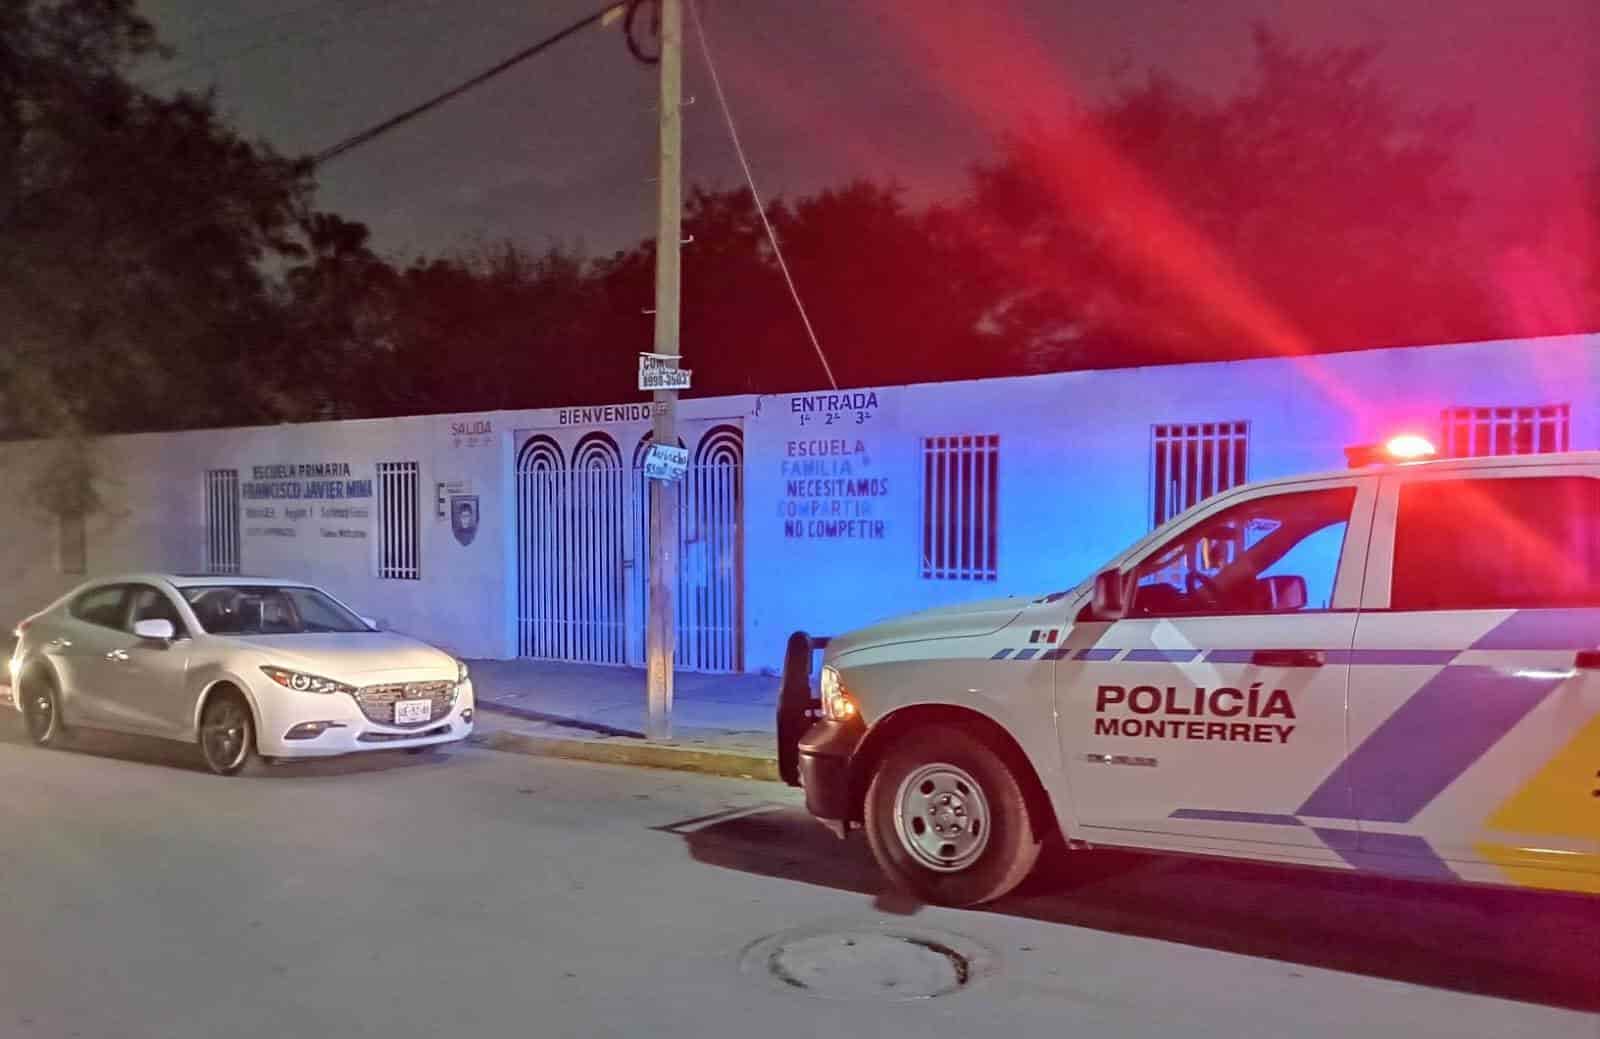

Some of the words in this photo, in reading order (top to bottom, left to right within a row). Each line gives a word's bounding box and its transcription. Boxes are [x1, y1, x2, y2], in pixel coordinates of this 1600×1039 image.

[791, 391, 878, 413] ENTRADA
[451, 420, 493, 437] SALIDA
[787, 439, 865, 457] ESCUELA
[299, 462, 351, 478] PRIMARIA
[780, 459, 852, 477] FAMILIA
[303, 480, 344, 499] JAVIER
[787, 478, 889, 497] NECESITAMOS
[785, 519, 803, 539] NO
[808, 519, 885, 539] COMPETIR
[1095, 683, 1296, 719] POLICÍA
[1094, 718, 1296, 744] MONTERREY
